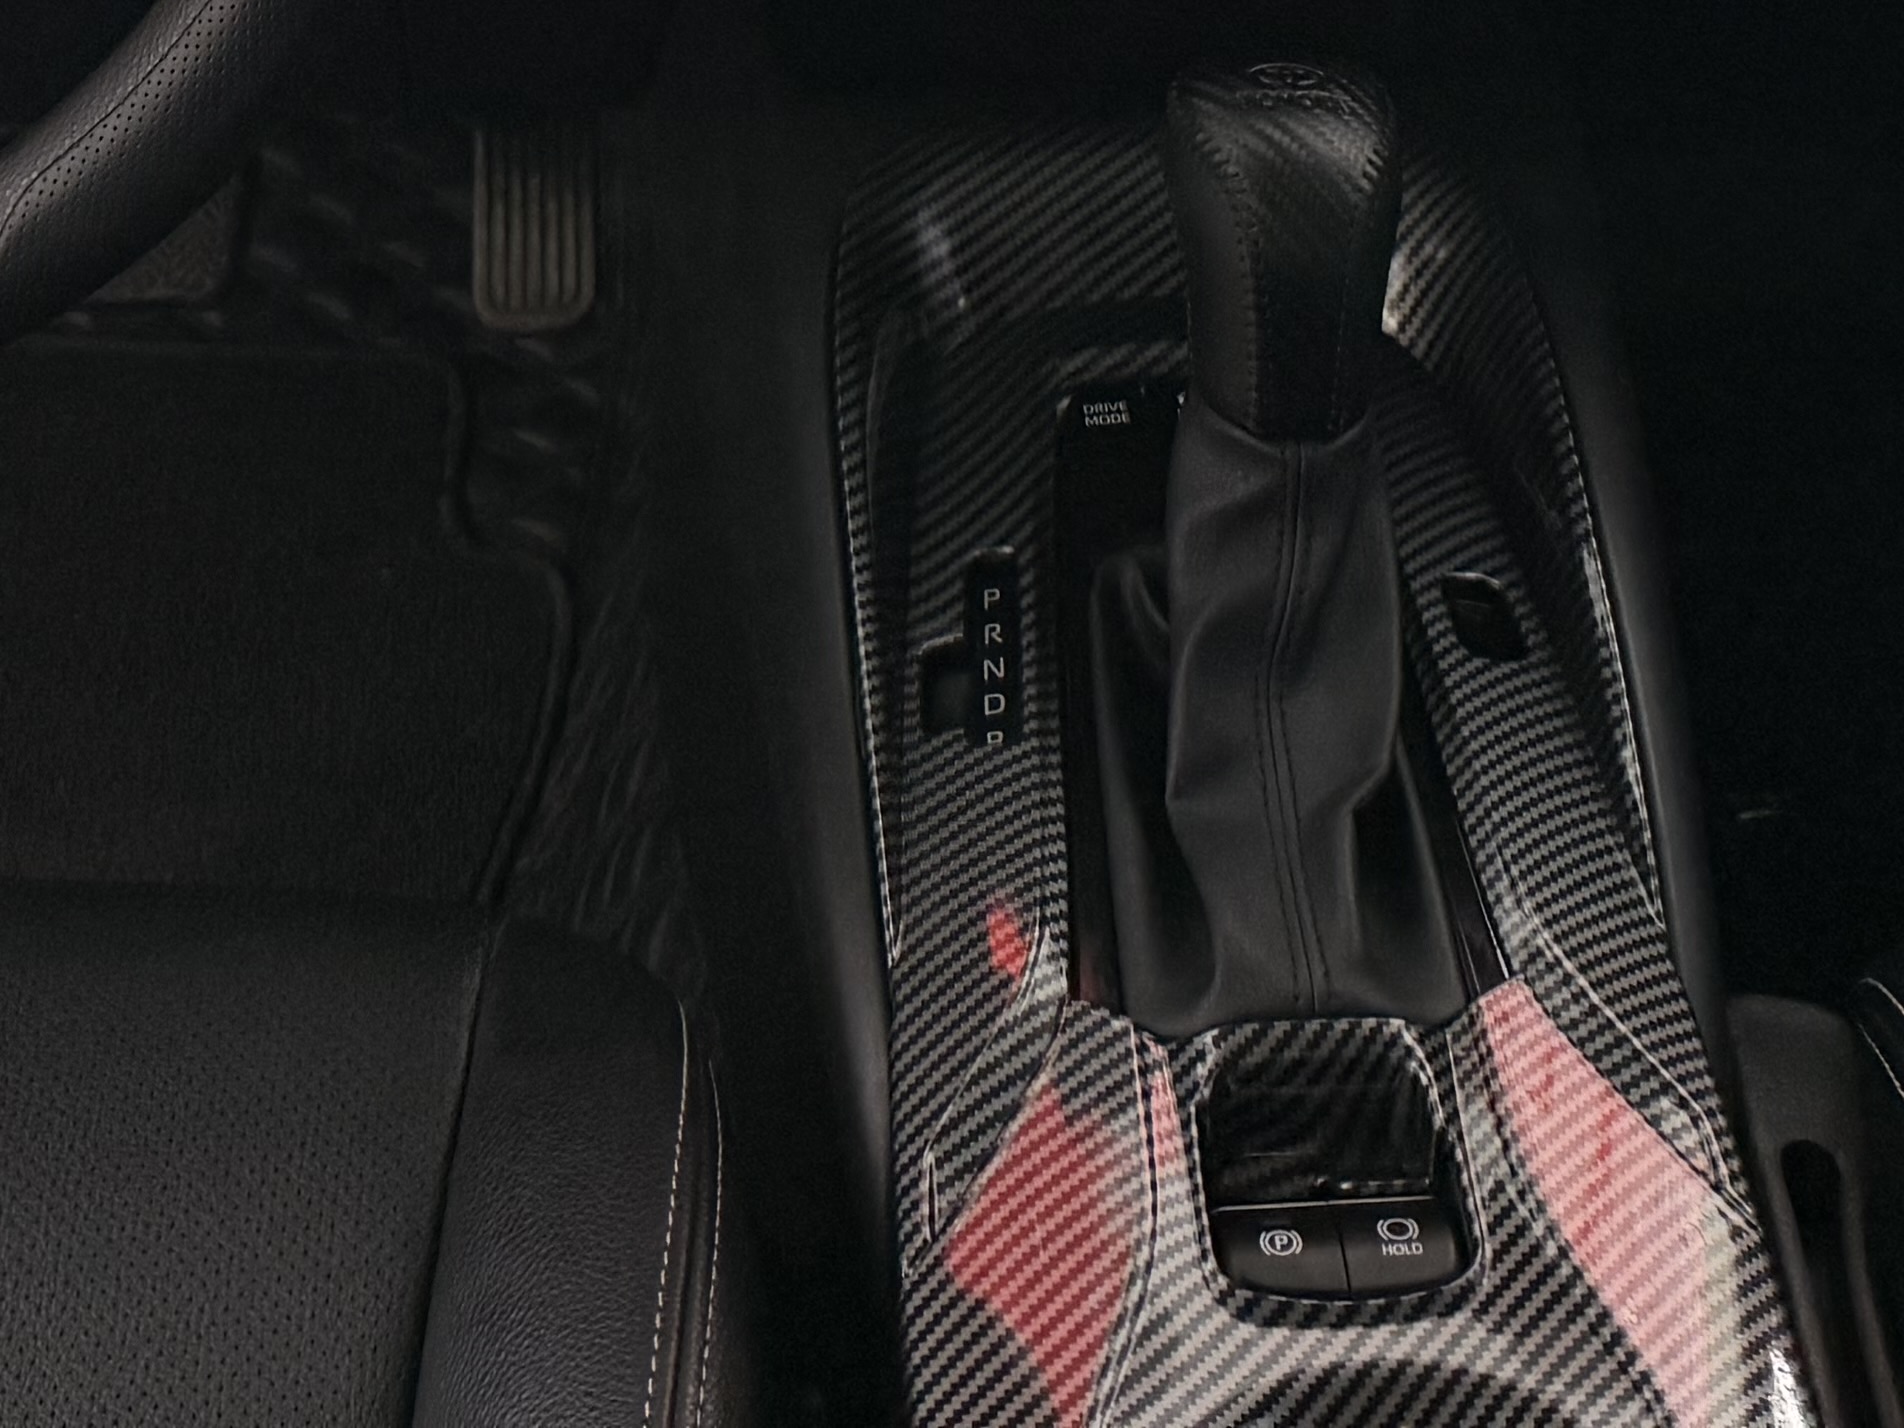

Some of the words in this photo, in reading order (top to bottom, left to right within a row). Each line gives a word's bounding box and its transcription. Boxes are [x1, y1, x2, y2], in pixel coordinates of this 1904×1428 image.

[1082, 399, 1128, 415] DRIVE
[1084, 411, 1132, 429] MODE
[983, 588, 1001, 612] P
[984, 623, 1004, 646] R
[983, 655, 1005, 681] N
[983, 692, 1006, 717] D
[1381, 1241, 1425, 1257] HOLD
